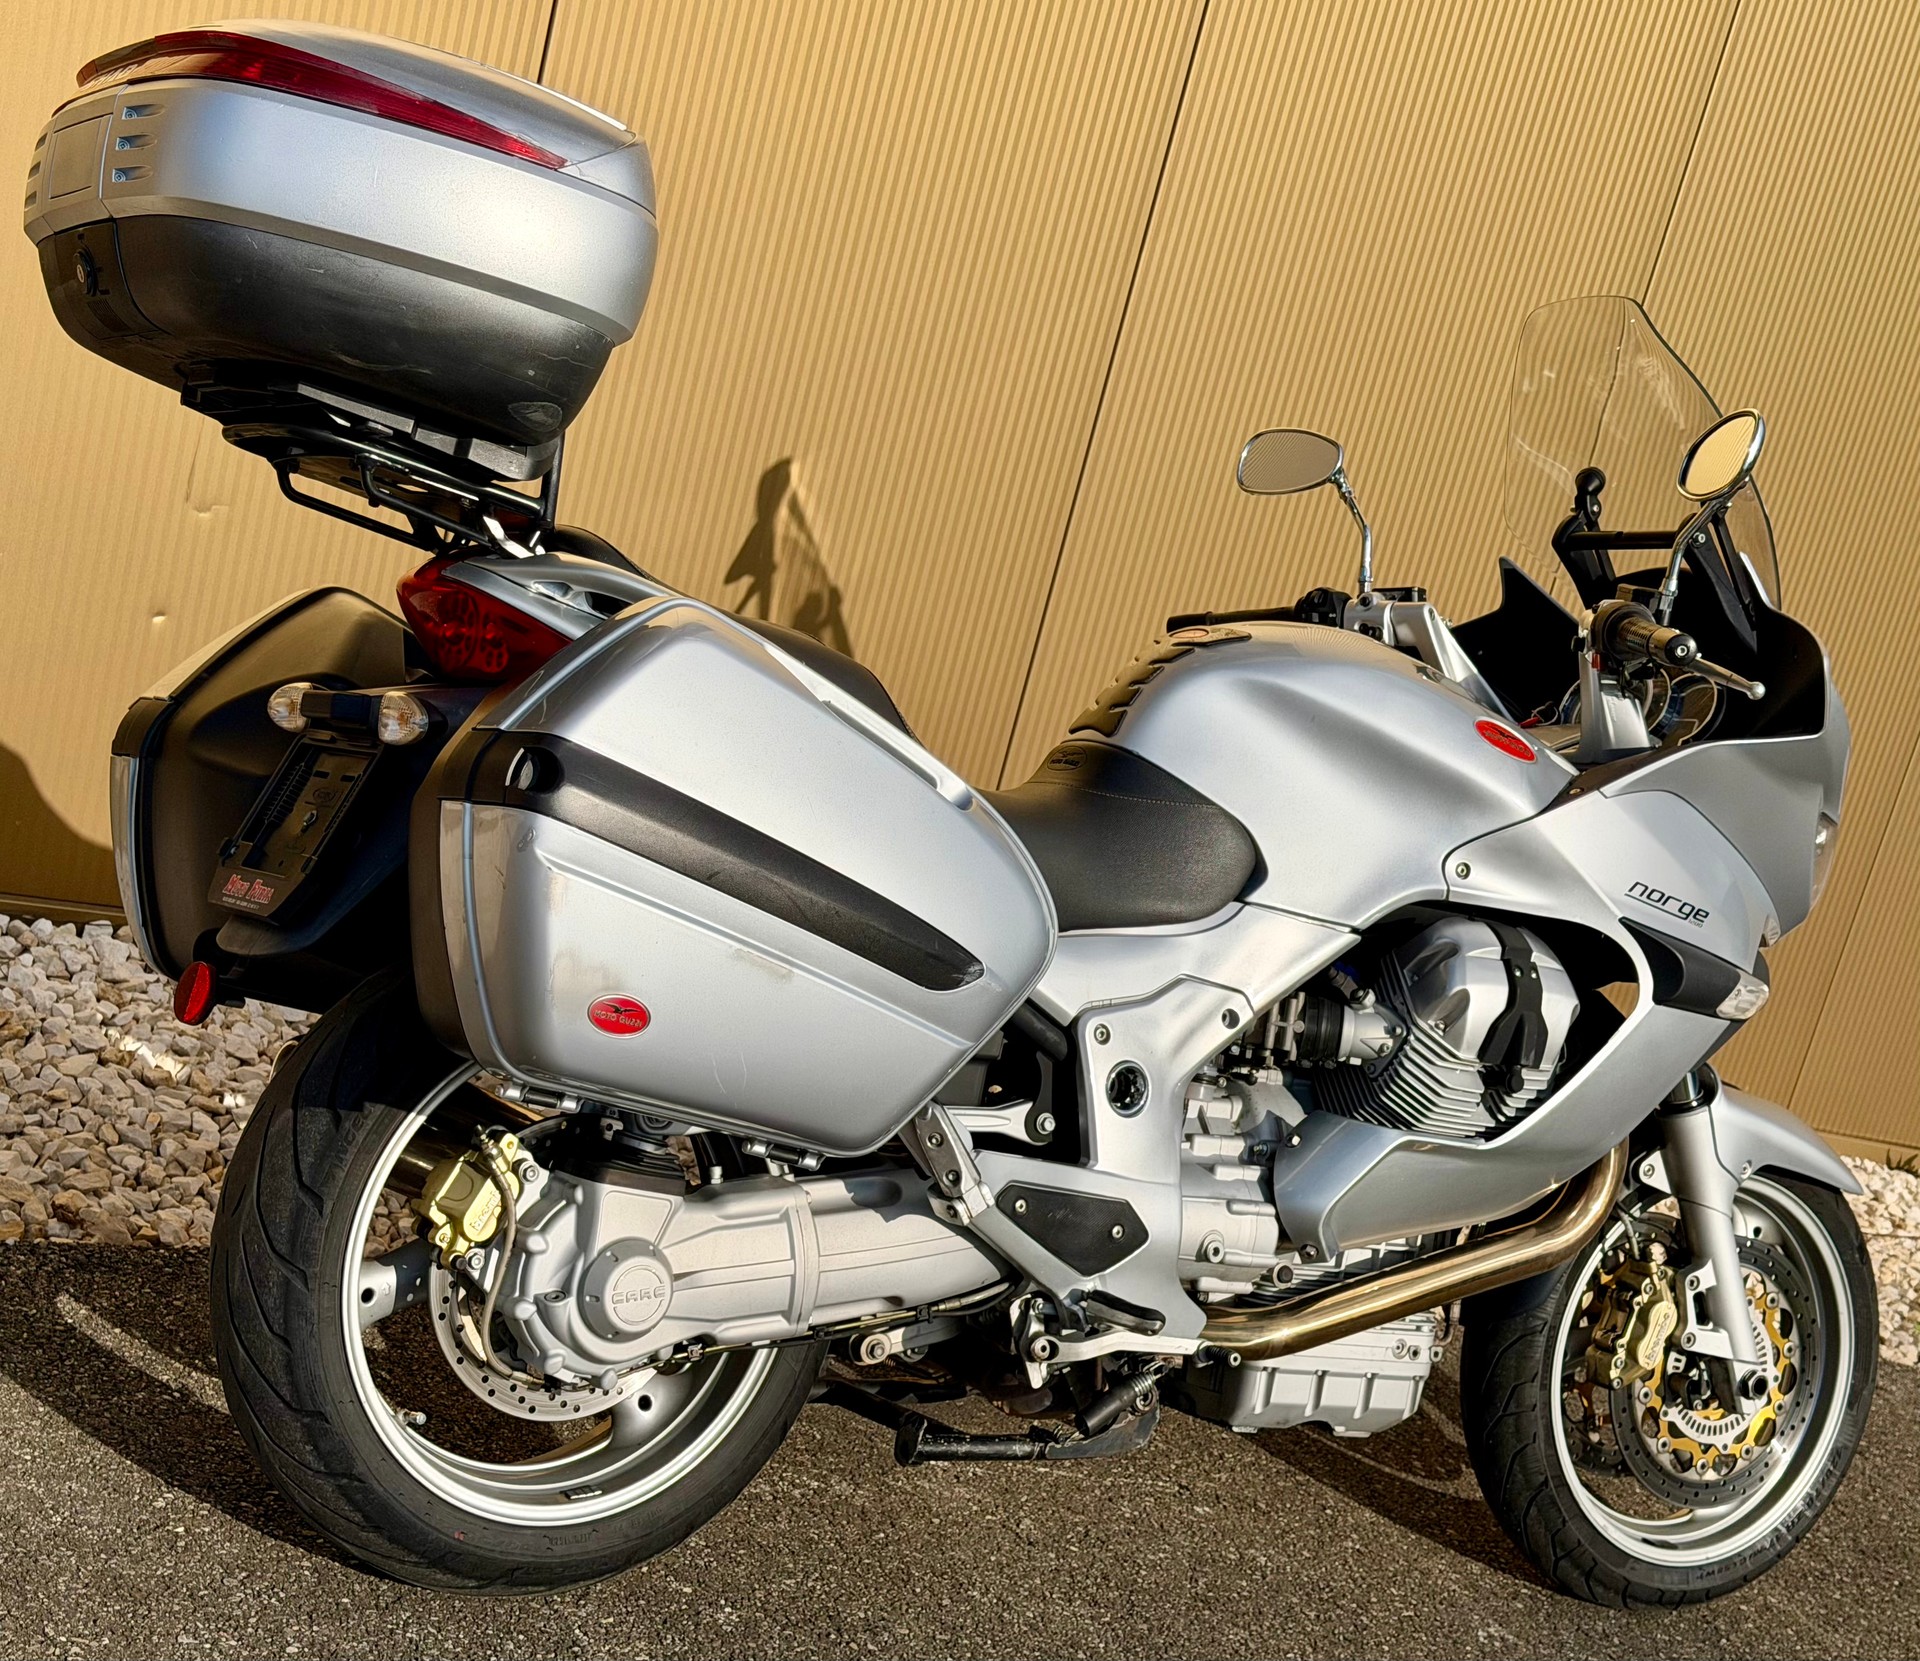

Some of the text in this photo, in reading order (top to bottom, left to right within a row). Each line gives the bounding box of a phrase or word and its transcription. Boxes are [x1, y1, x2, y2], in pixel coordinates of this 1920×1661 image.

[1624, 881, 1710, 924] norge
[593, 1010, 644, 1028] MOTO GUZZI
[1645, 1312, 1671, 1361] brembo
